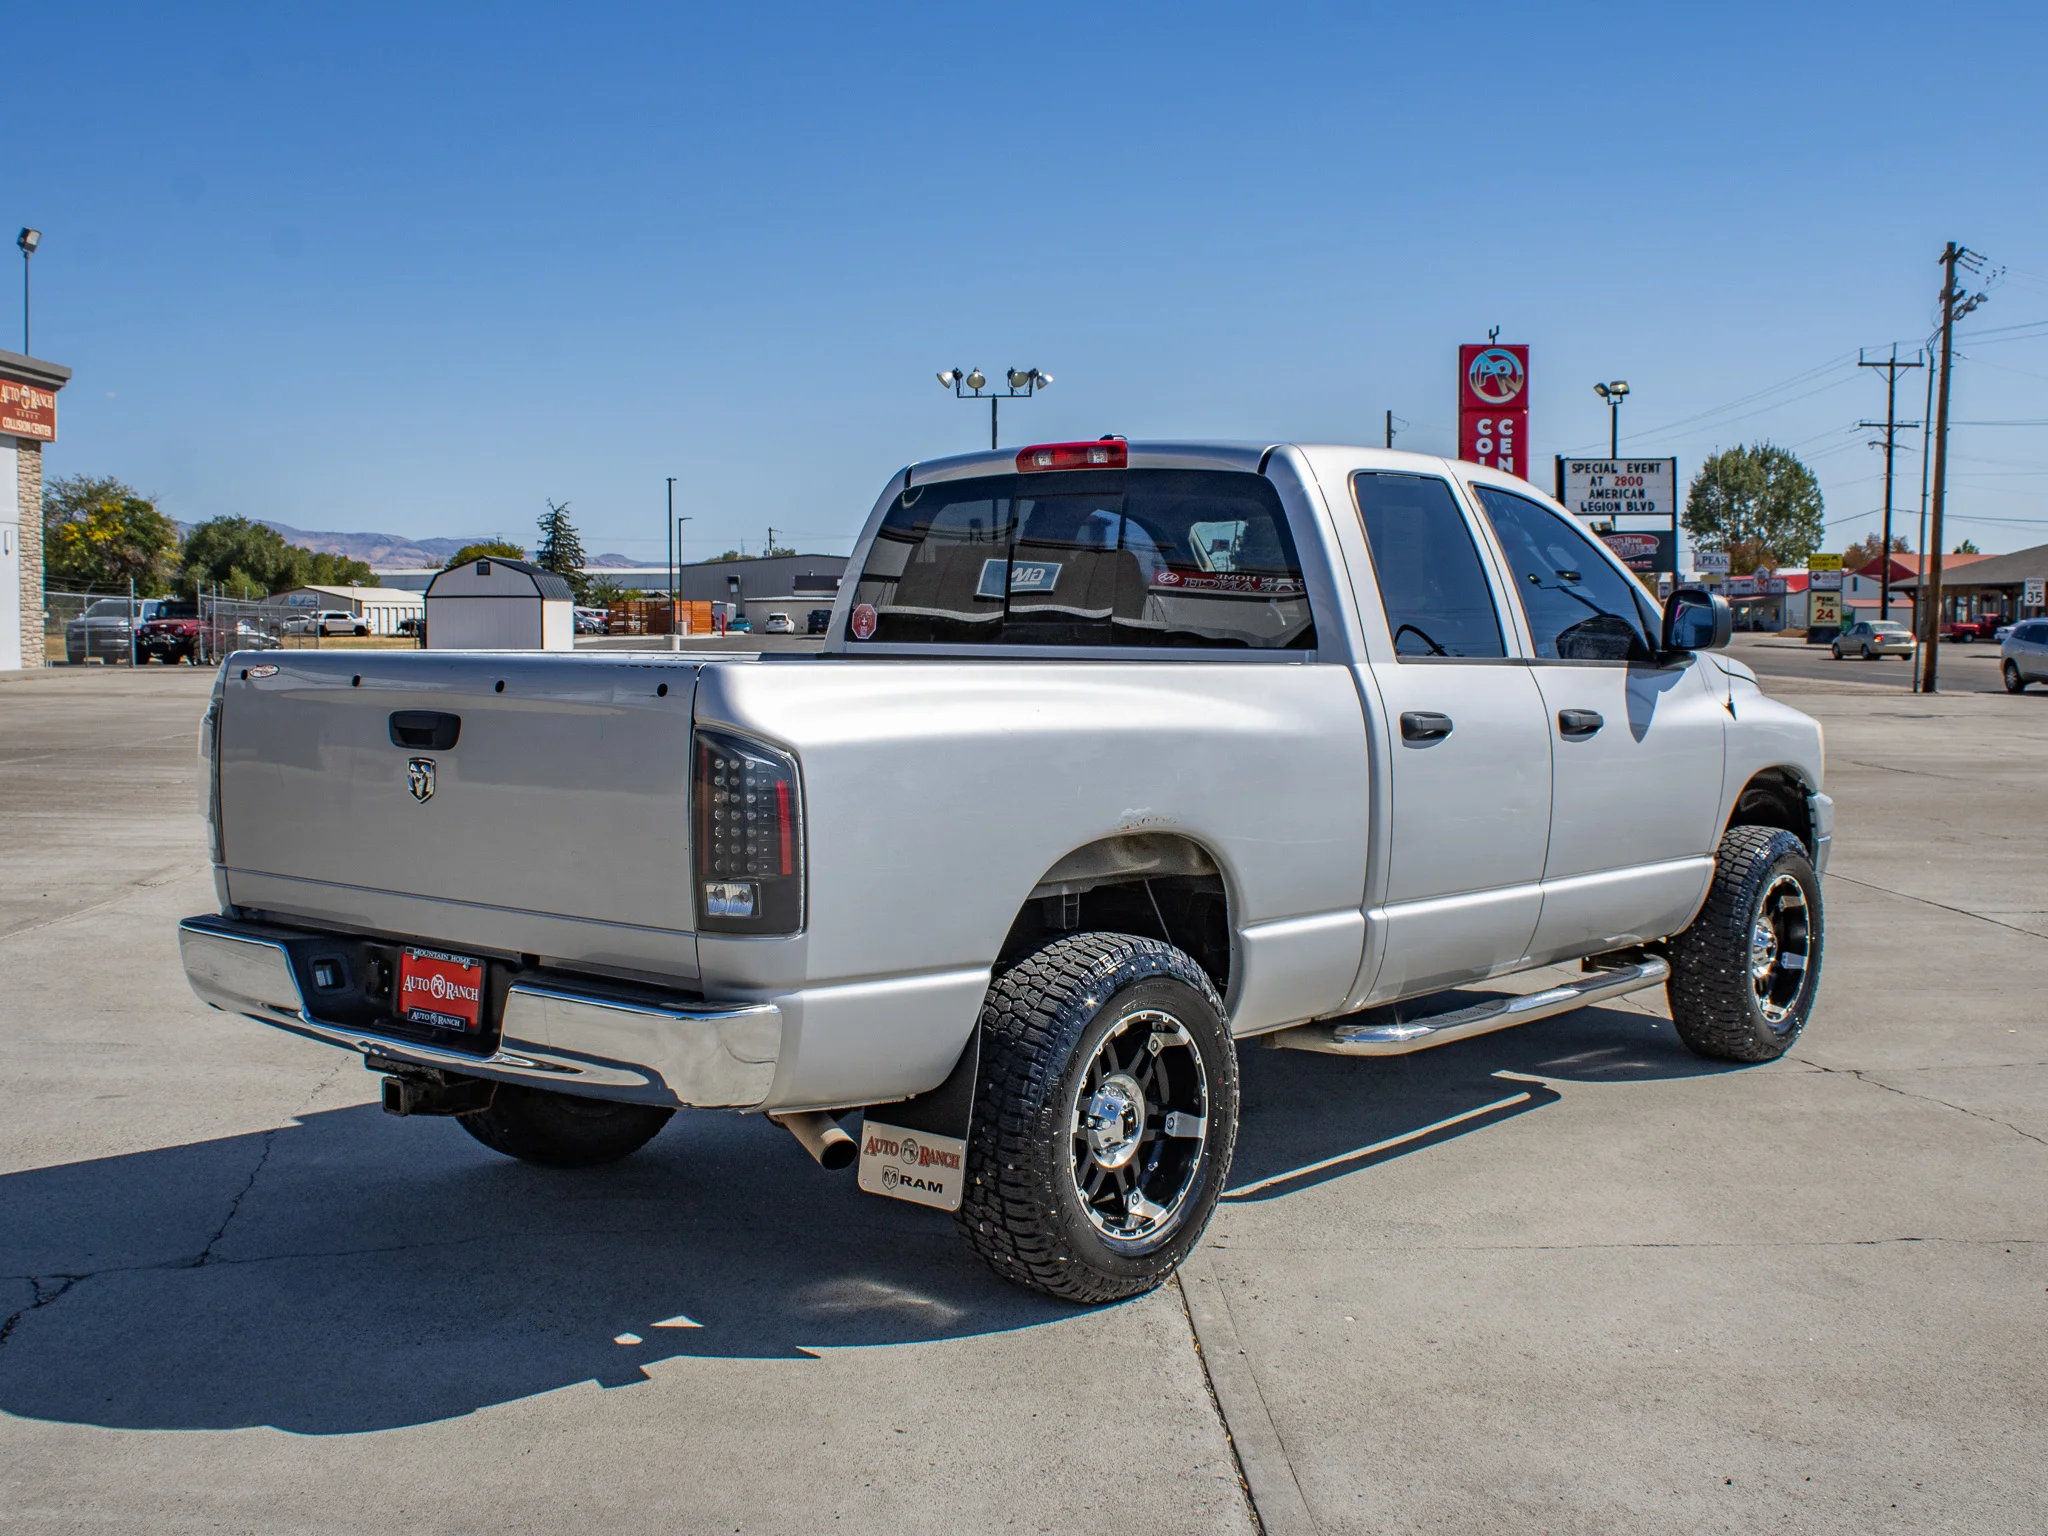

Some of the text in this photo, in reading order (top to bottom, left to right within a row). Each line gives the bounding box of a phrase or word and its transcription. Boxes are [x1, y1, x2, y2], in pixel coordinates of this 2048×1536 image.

[0, 384, 54, 409] AUTO RANCH
[31, 422, 52, 437] CENTER
[1571, 463, 1661, 474] SPECIAL EVENT
[1590, 476, 1644, 486] AT 2800
[1589, 489, 1645, 499] AMERICAN
[1581, 501, 1655, 512] LEGION BLVD
[1702, 556, 1729, 565] PEAK
[2027, 591, 2043, 604] 35
[1816, 608, 1835, 620] 24
[413, 947, 471, 966] MOUNTAIN HOME
[403, 974, 479, 1001] AUTO RANCH
[411, 1010, 460, 1027] AUTO RANCH
[863, 1135, 961, 1170] AUTO RANCH
[900, 1174, 943, 1194] RAM
